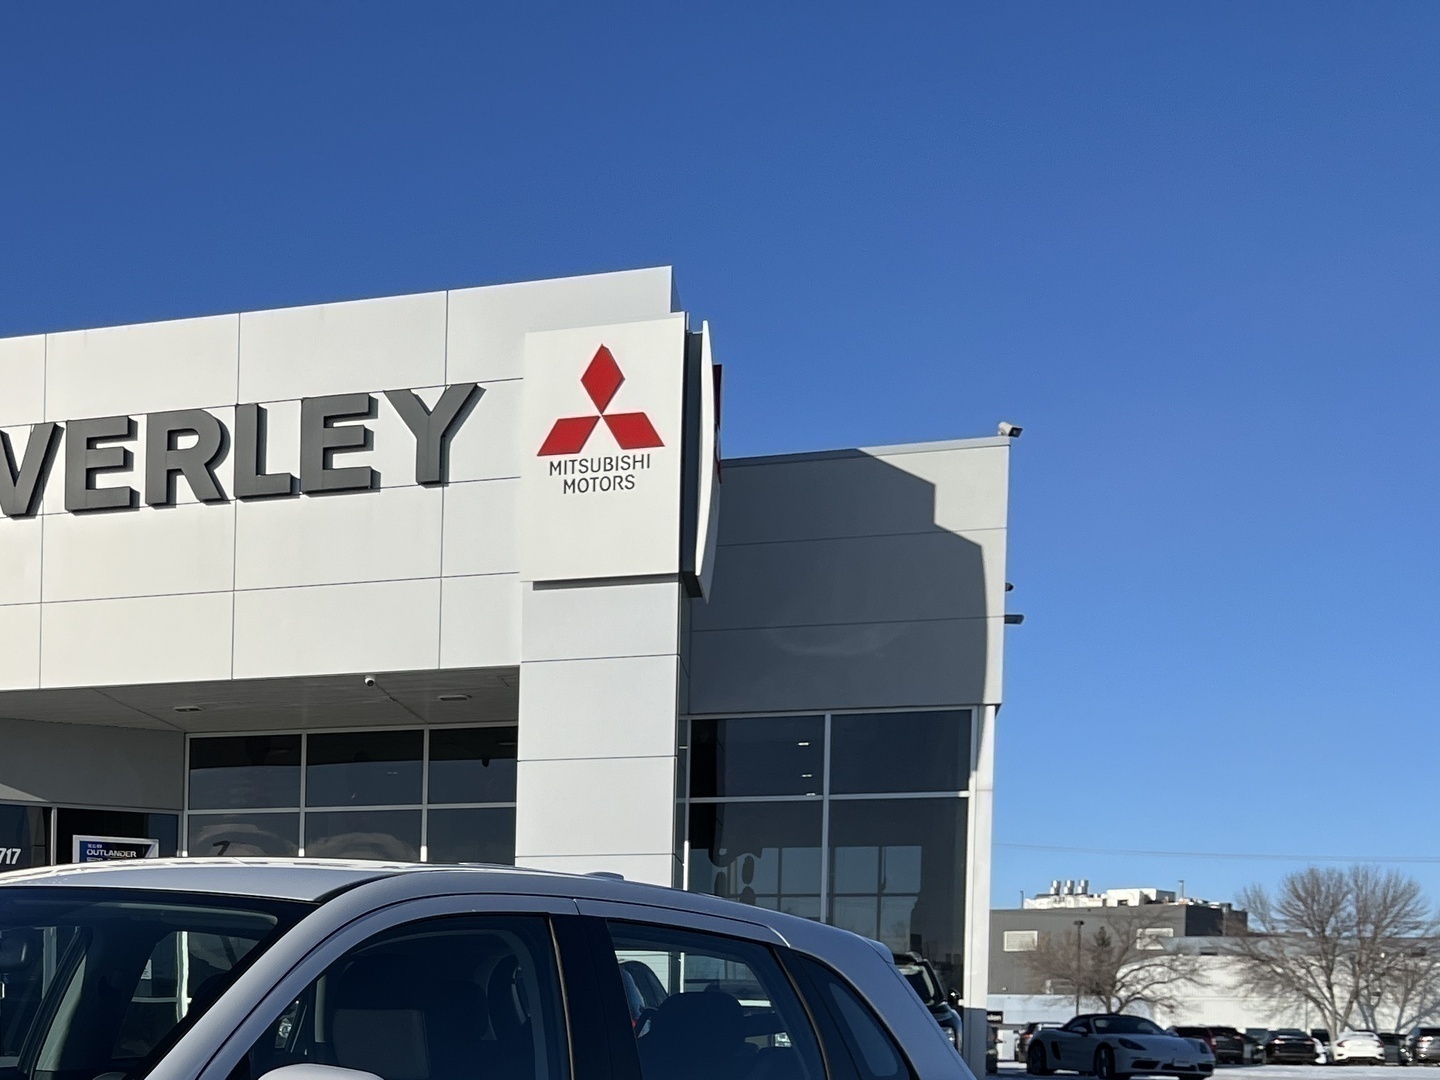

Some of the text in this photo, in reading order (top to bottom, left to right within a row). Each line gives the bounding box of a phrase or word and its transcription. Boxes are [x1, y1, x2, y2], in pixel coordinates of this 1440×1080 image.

[549, 453, 651, 477] MITSUBISHI
[562, 474, 636, 495] MOTORS
[86, 848, 137, 858] OUTLANDER
